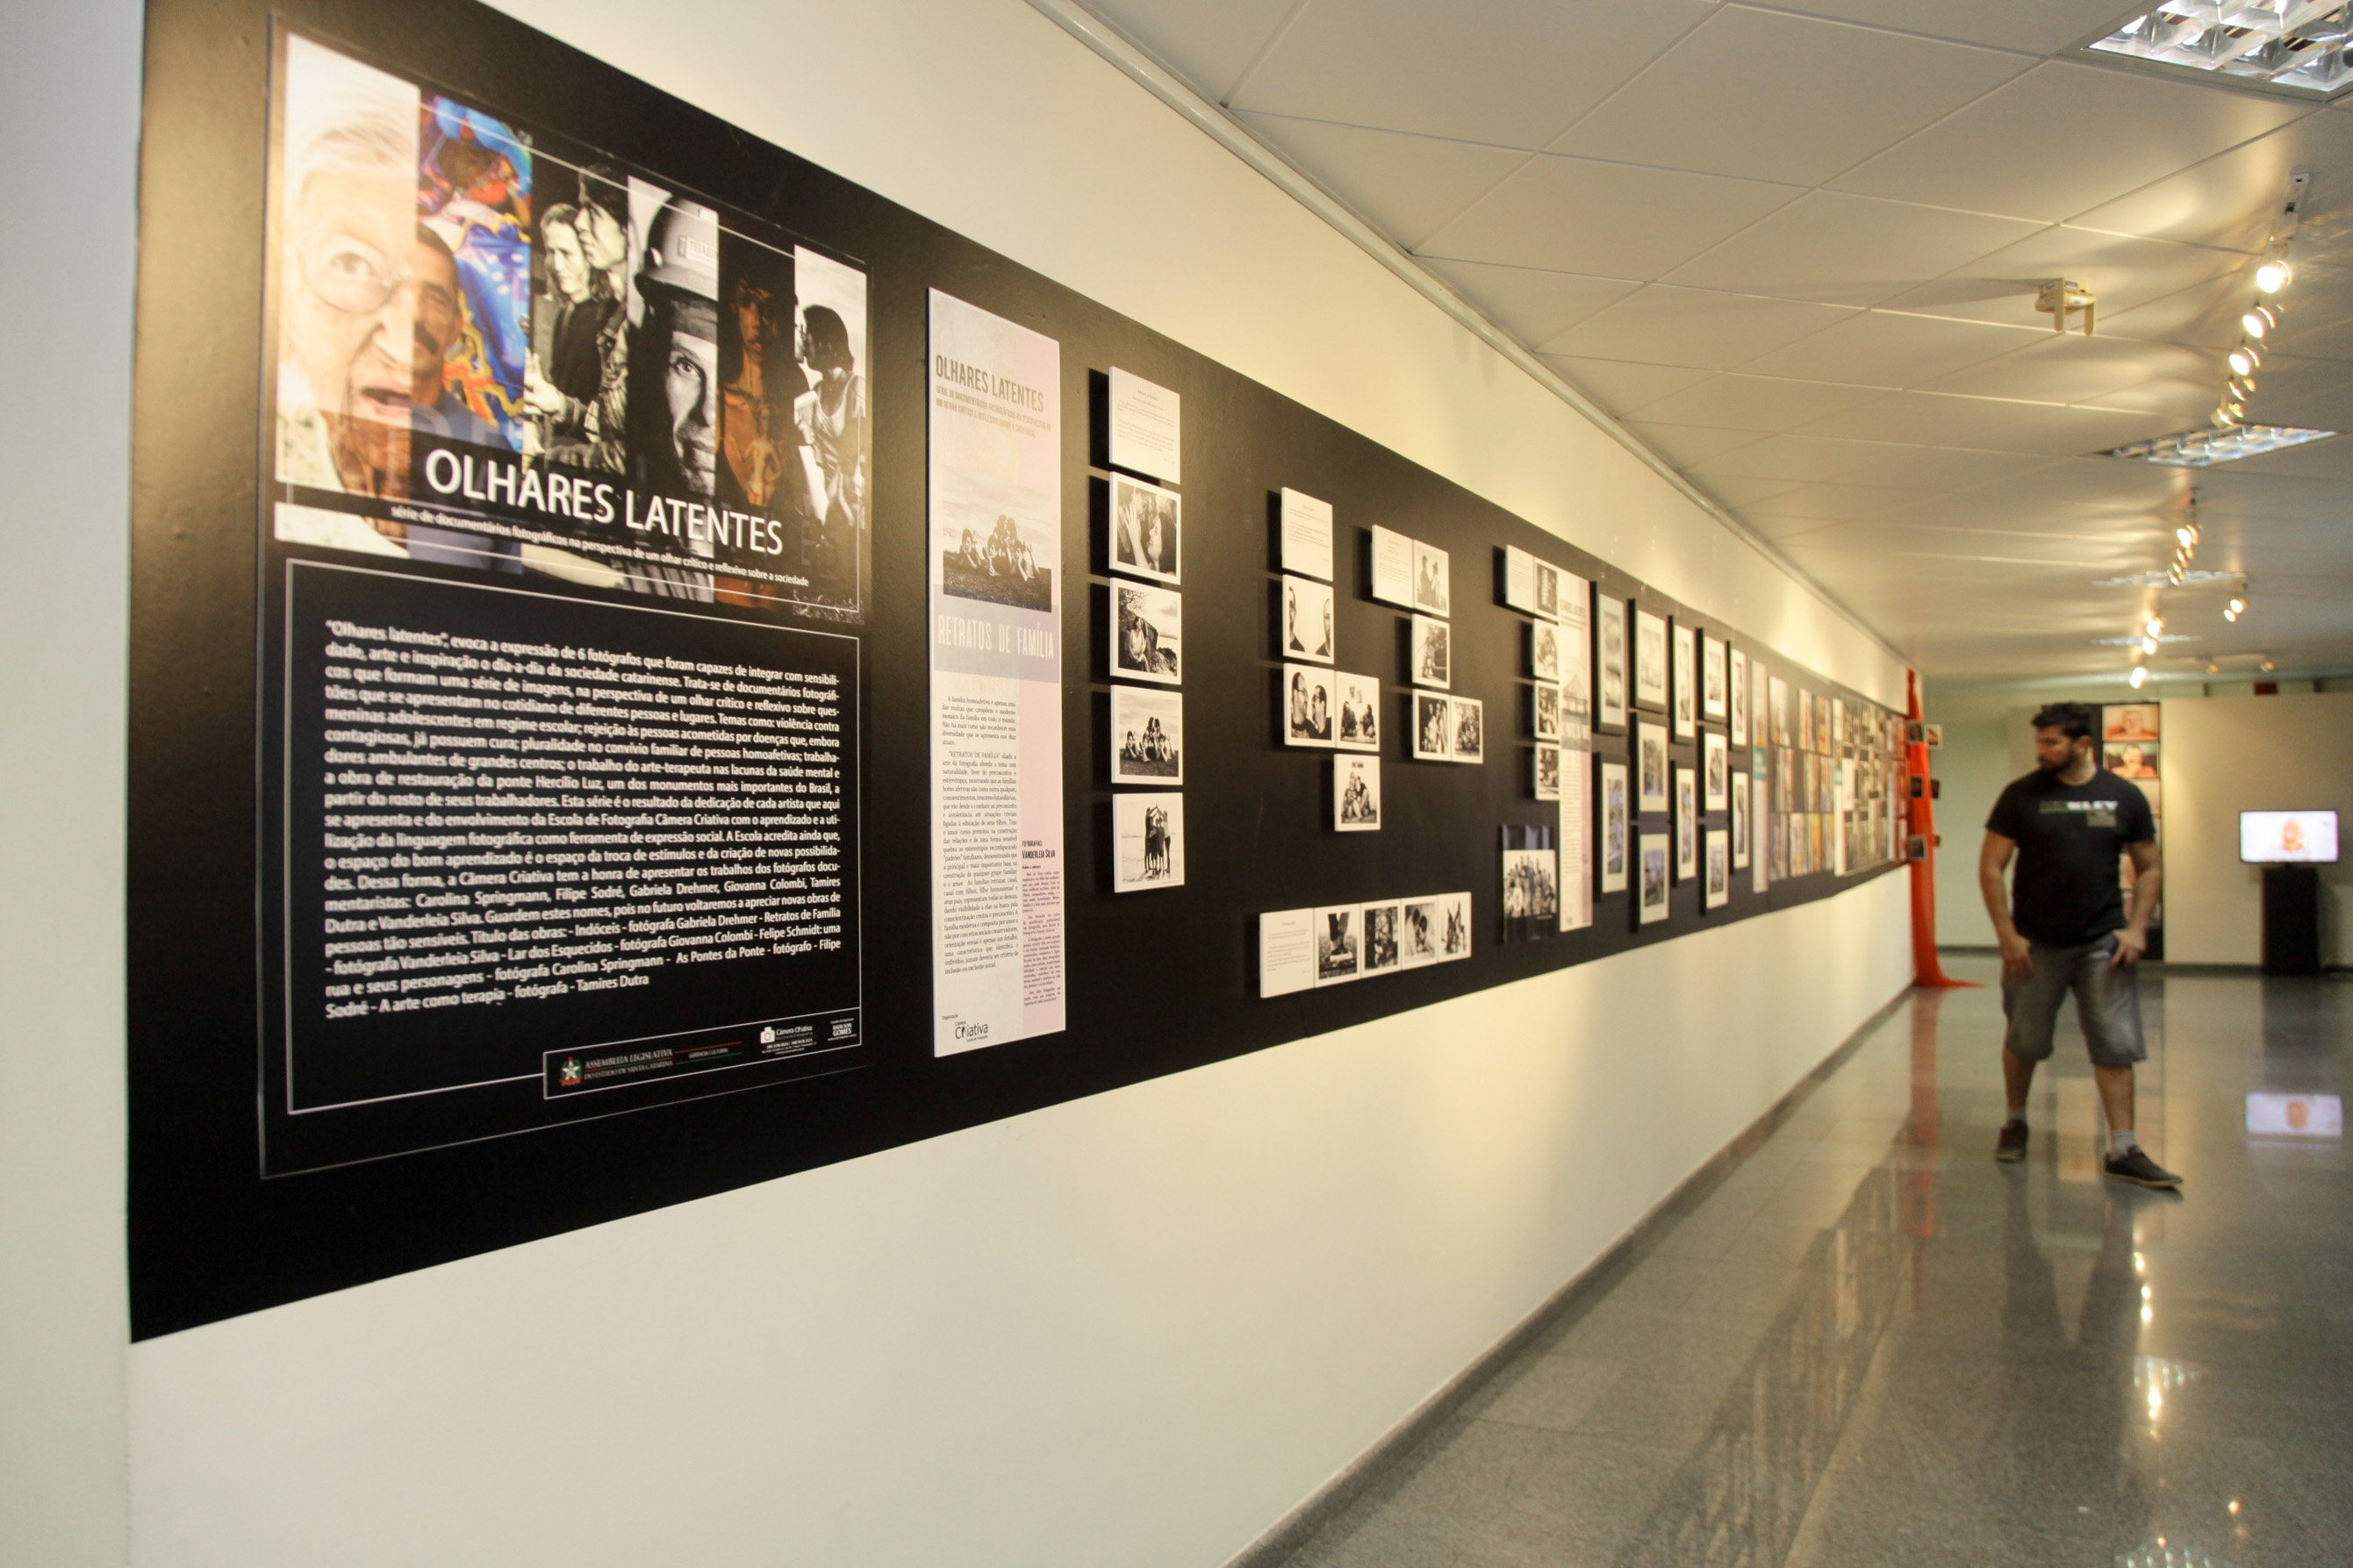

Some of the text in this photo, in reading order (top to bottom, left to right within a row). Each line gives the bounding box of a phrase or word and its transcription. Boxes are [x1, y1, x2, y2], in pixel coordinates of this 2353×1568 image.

[936, 354, 1044, 413] OLHARES LATENTES
[425, 447, 784, 555] OLHARES LATENTES
[938, 615, 1054, 659] RETRATOS DE FAMÍLIA
[642, 656, 664, 670] que
[664, 655, 695, 671] foram
[696, 662, 733, 677] capazes
[734, 663, 747, 677] de
[748, 666, 783, 683] integrar
[784, 671, 803, 682] com
[682, 676, 721, 691] Trata-se
[722, 679, 735, 691] de
[655, 690, 669, 704] de
[671, 694, 687, 705] um
[688, 693, 714, 707] olhar
[754, 698, 792, 712] reflexivo
[793, 702, 815, 714] sobre
[717, 712, 747, 726] Temas
[814, 720, 839, 732] contra
[640, 727, 680, 741] pessoas
[680, 727, 735, 741] acometidas
[735, 733, 751, 745] por
[808, 734, 839, 747] embora
[649, 742, 688, 756] familiar
[689, 744, 703, 757] de
[704, 748, 741, 761] pessoas
[639, 761, 712, 777] arte-terapeuta
[713, 765, 729, 775] nas
[730, 763, 764, 776] lacunas
[765, 764, 778, 776] da
[805, 766, 833, 777] mental
[649, 779, 714, 791] monumentos
[716, 780, 738, 791] mais
[741, 781, 793, 795] importantes
[795, 782, 807, 793] do
[679, 796, 693, 807] da
[742, 797, 755, 808] de
[756, 797, 777, 808] cada
[777, 798, 804, 809] artista
[805, 800, 821, 811] que
[821, 798, 840, 811] aqui
[693, 813, 729, 825] Criativa
[730, 816, 750, 825] com
[759, 813, 812, 827] aprendizado
[735, 830, 763, 841] Escola
[763, 829, 798, 841] acredita
[799, 829, 821, 841] ainda
[706, 847, 719, 859] da
[754, 846, 766, 857] de
[768, 848, 793, 857] novas
[641, 866, 694, 881] apresentar
[696, 867, 708, 877] os
[709, 863, 753, 876] trabalhos
[755, 863, 771, 874] dos
[723, 878, 766, 891] Giovanna
[809, 876, 840, 888] Tamires
[636, 891, 841, 914] no futuro voltaremos apreciar novas obras de
[676, 914, 716, 929] Gabriela
[718, 912, 757, 926] Drehmer
[764, 909, 800, 922] Retratos
[800, 908, 811, 920] de
[667, 932, 714, 947] Giovanna
[714, 928, 753, 943] Colombi
[759, 926, 786, 942] Felipe
[822, 925, 841, 934] uma
[676, 951, 689, 963] As
[691, 948, 722, 963] Pontes
[724, 947, 737, 959] da
[739, 944, 765, 957] Ponte
[819, 937, 841, 952] Filipe
